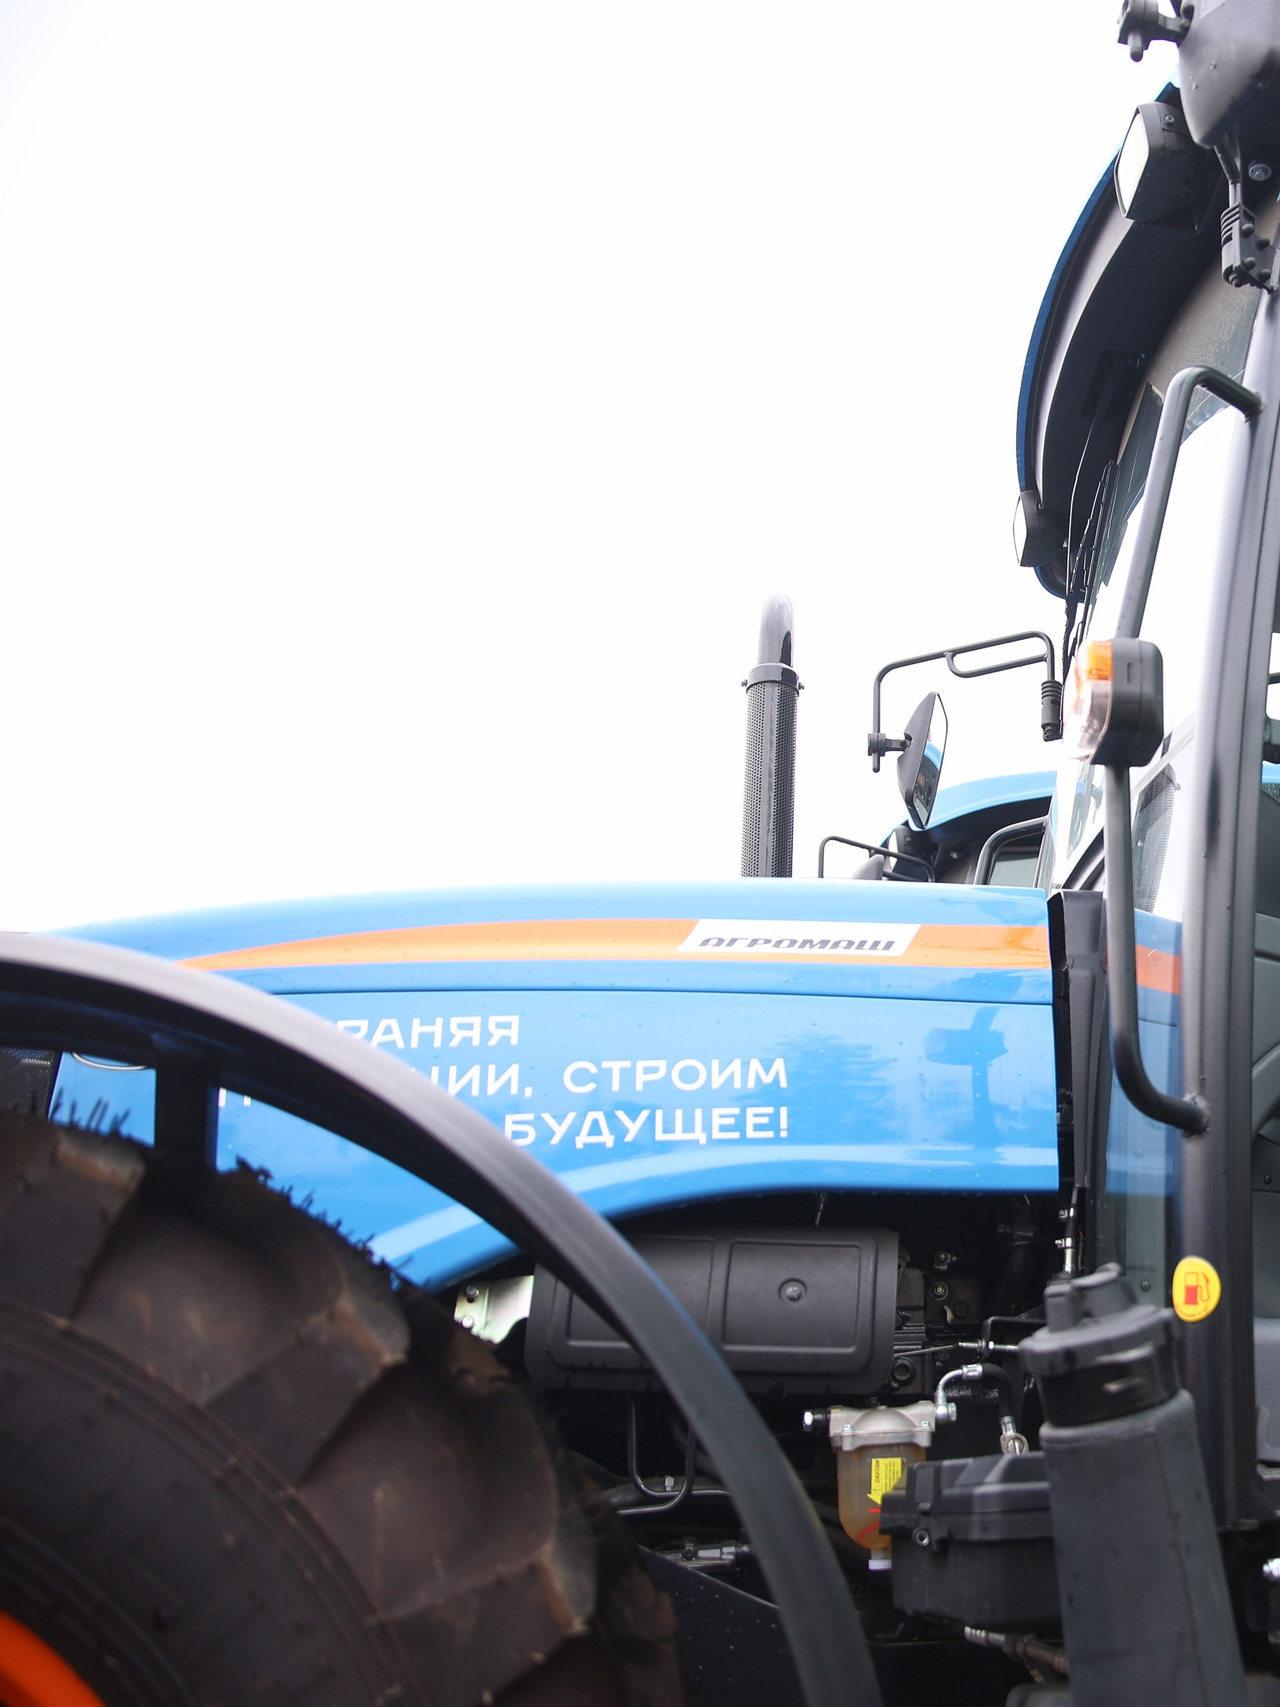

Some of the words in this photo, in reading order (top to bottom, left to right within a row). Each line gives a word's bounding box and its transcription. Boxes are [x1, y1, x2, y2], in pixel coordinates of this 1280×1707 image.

[698, 936, 896, 951] АГРОМАШ
[329, 1014, 520, 1049] РАНЯЯ
[562, 1057, 788, 1094] СТРОИМ
[503, 1105, 788, 1149] БУДУЩЕЕ!
